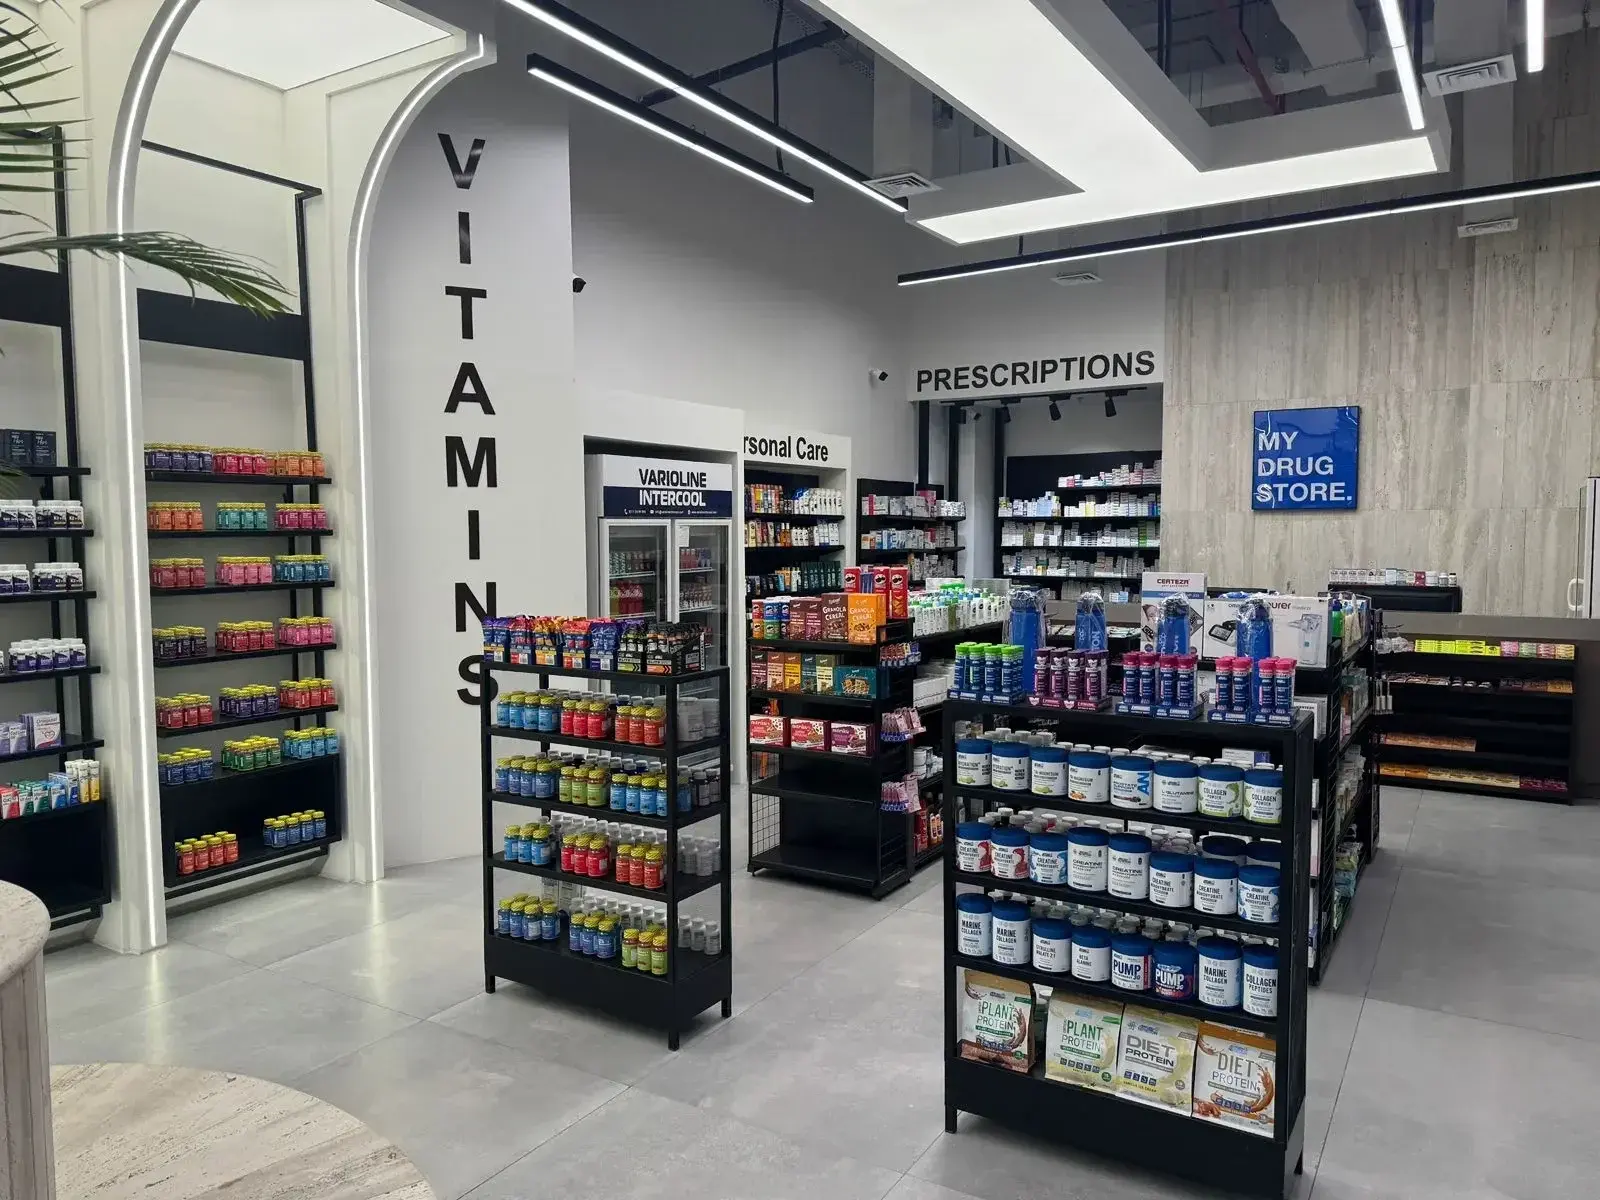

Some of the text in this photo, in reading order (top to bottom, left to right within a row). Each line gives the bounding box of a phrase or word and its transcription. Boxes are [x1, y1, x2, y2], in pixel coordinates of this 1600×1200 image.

[917, 350, 1155, 392] PRESCRIPTIONS
[437, 132, 499, 706] VITAMINS
[743, 435, 829, 462] rsonal Care
[1258, 431, 1298, 451] MY
[1257, 456, 1334, 477] DRUG
[639, 468, 707, 488] VARIOLINE
[640, 489, 706, 507] INTERCOOL
[1256, 482, 1352, 502] STORE.
[1204, 787, 1227, 796] COLLAGEN
[1252, 794, 1277, 802] COLLAGEN
[1199, 885, 1221, 895] CREATINE
[1246, 892, 1270, 902] CREATINE
[961, 928, 982, 936] COLLAGEN
[962, 920, 981, 930] MARINE
[997, 927, 1017, 938] MARINE
[996, 935, 1017, 944] COLLAGEN
[1114, 959, 1142, 977] PUMP
[1204, 966, 1228, 978] MARINE
[1156, 968, 1185, 987] PUMP
[1204, 976, 1228, 985] COLLAGEN
[1246, 974, 1277, 988] COLLAGEN
[1249, 985, 1273, 994] PEPTIDES
[982, 1001, 1014, 1021] PLANT
[977, 1015, 1014, 1030] PROTEIN
[1067, 1020, 1104, 1041] PLANT
[1062, 1034, 1101, 1052] PROTEIN
[1126, 1035, 1176, 1059] DIET
[1126, 1048, 1175, 1067] PROTEIN
[1218, 1052, 1255, 1078] DIET
[1212, 1071, 1258, 1091] PROTEIN
